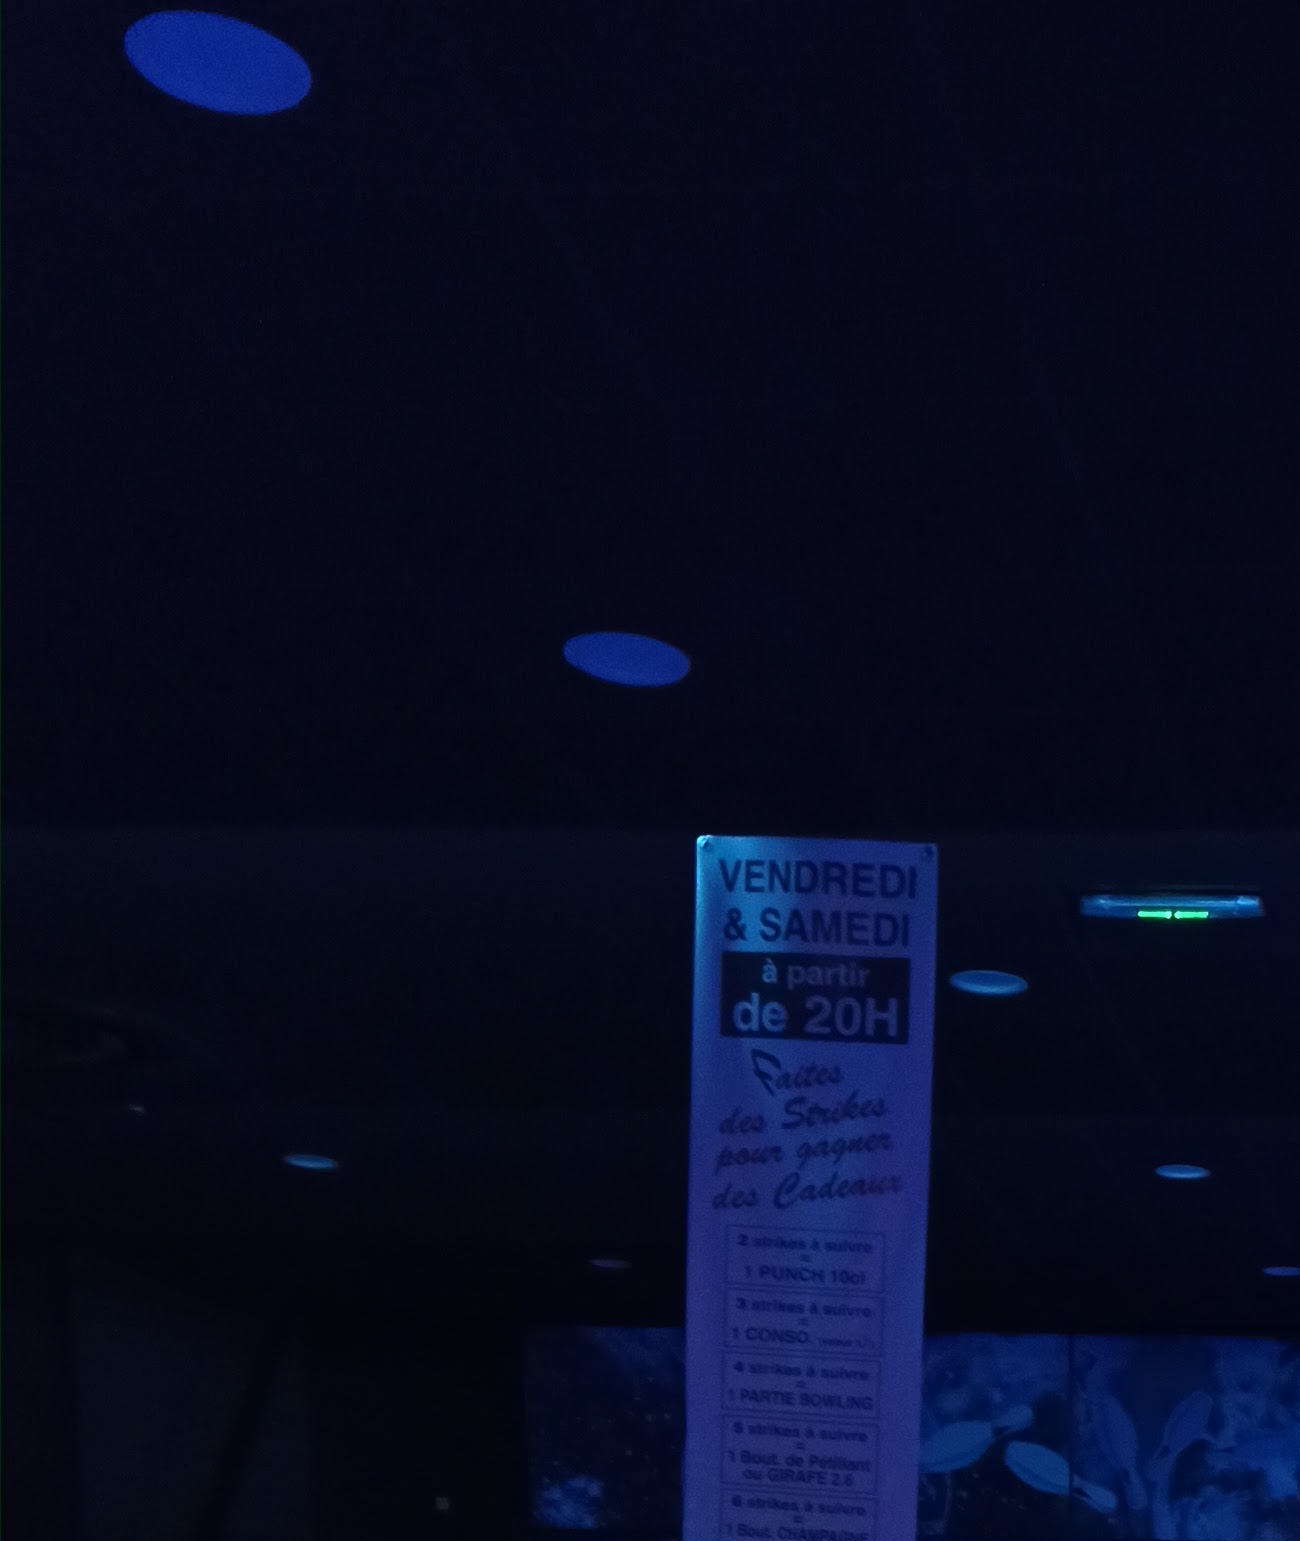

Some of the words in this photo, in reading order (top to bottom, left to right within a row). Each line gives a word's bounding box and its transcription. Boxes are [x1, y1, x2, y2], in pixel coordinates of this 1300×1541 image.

[719, 859, 917, 900] VENDREDI
[723, 908, 748, 942] &
[759, 907, 910, 948] SAMEDI
[760, 957, 778, 985] à
[786, 960, 872, 990] partir
[732, 991, 788, 1033] de
[803, 994, 899, 1038] 20H
[751, 1048, 843, 1096] Faites
[718, 1106, 767, 1136] des
[780, 1089, 886, 1132] Strikes
[713, 1146, 784, 1176] pour
[796, 1132, 893, 1169] gagner
[712, 1183, 758, 1210] des
[772, 1171, 902, 1210] Cadeaux
[737, 1234, 748, 1246] 2
[759, 1265, 824, 1282] PUNCH
[736, 1297, 746, 1309] 3
[741, 1389, 794, 1405] PARTIE
[799, 1393, 873, 1410] BOWLING
[768, 1468, 827, 1484] GIRAFE
